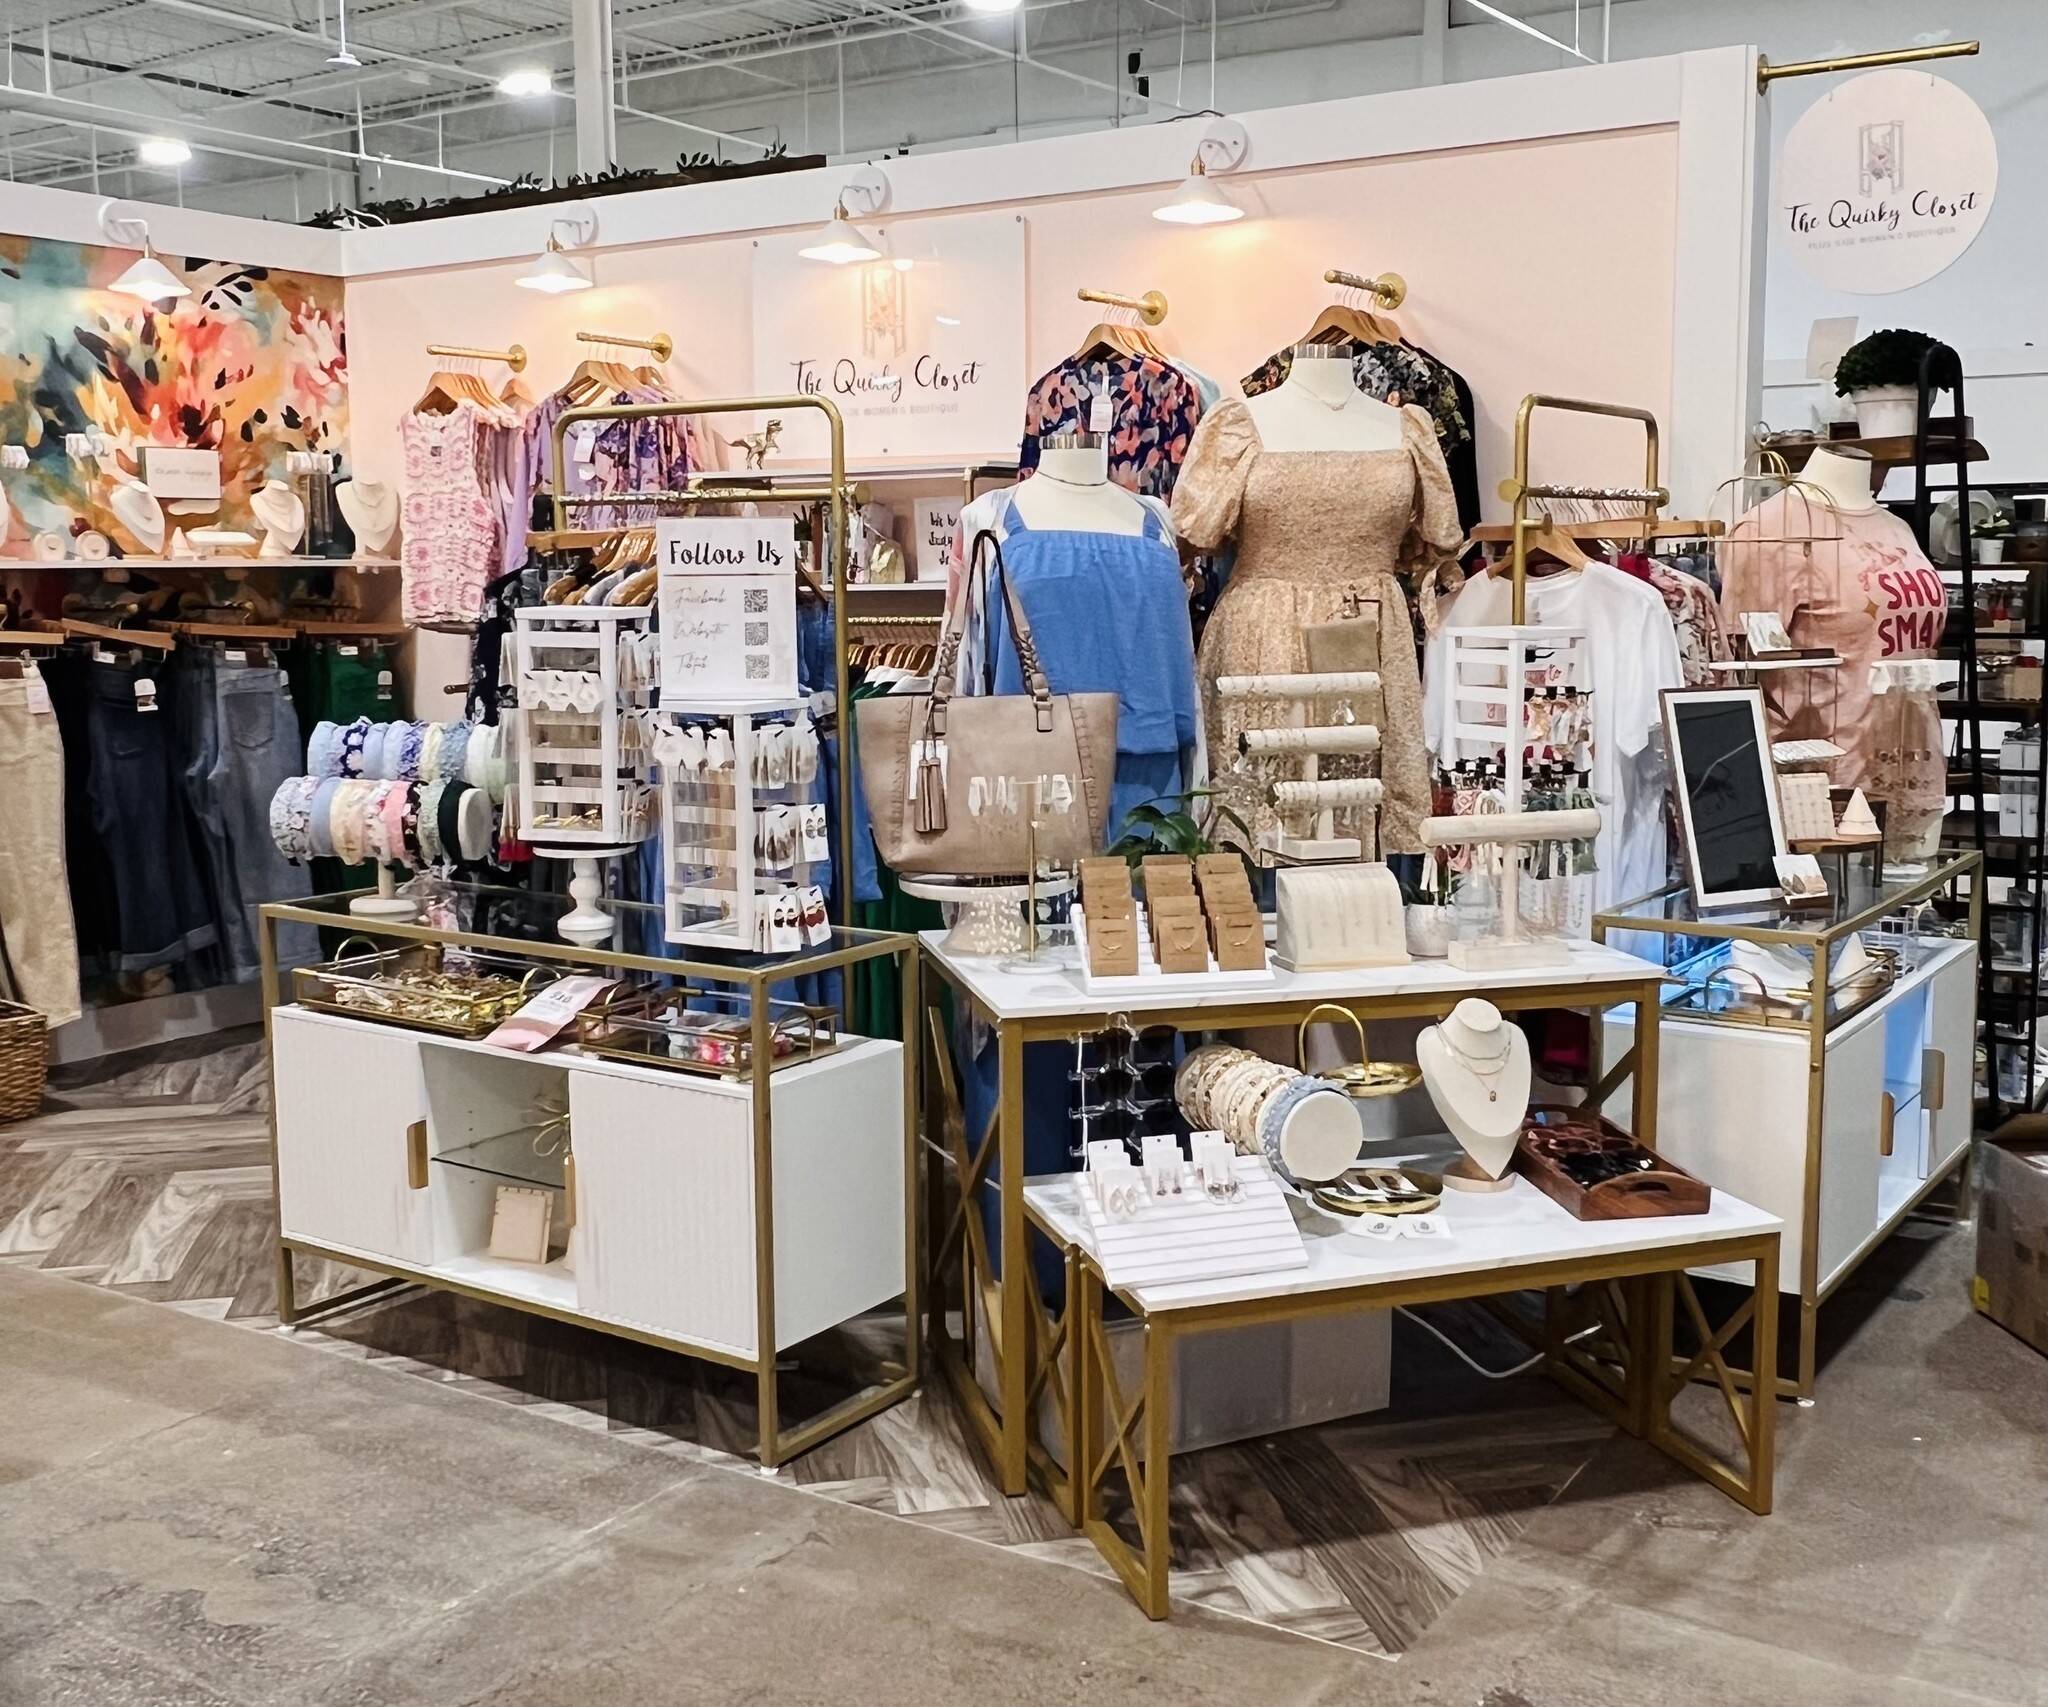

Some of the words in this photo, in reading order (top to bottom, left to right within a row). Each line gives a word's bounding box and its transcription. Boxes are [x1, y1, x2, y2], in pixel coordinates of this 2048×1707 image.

[1784, 203, 1819, 233] The
[1829, 199, 1900, 231] Quirky
[1912, 190, 1982, 218] Closet
[790, 359, 824, 395] The
[915, 354, 985, 391] Closet
[670, 540, 745, 565] Follow
[757, 539, 784, 566] Us
[1878, 568, 1946, 610] SHO
